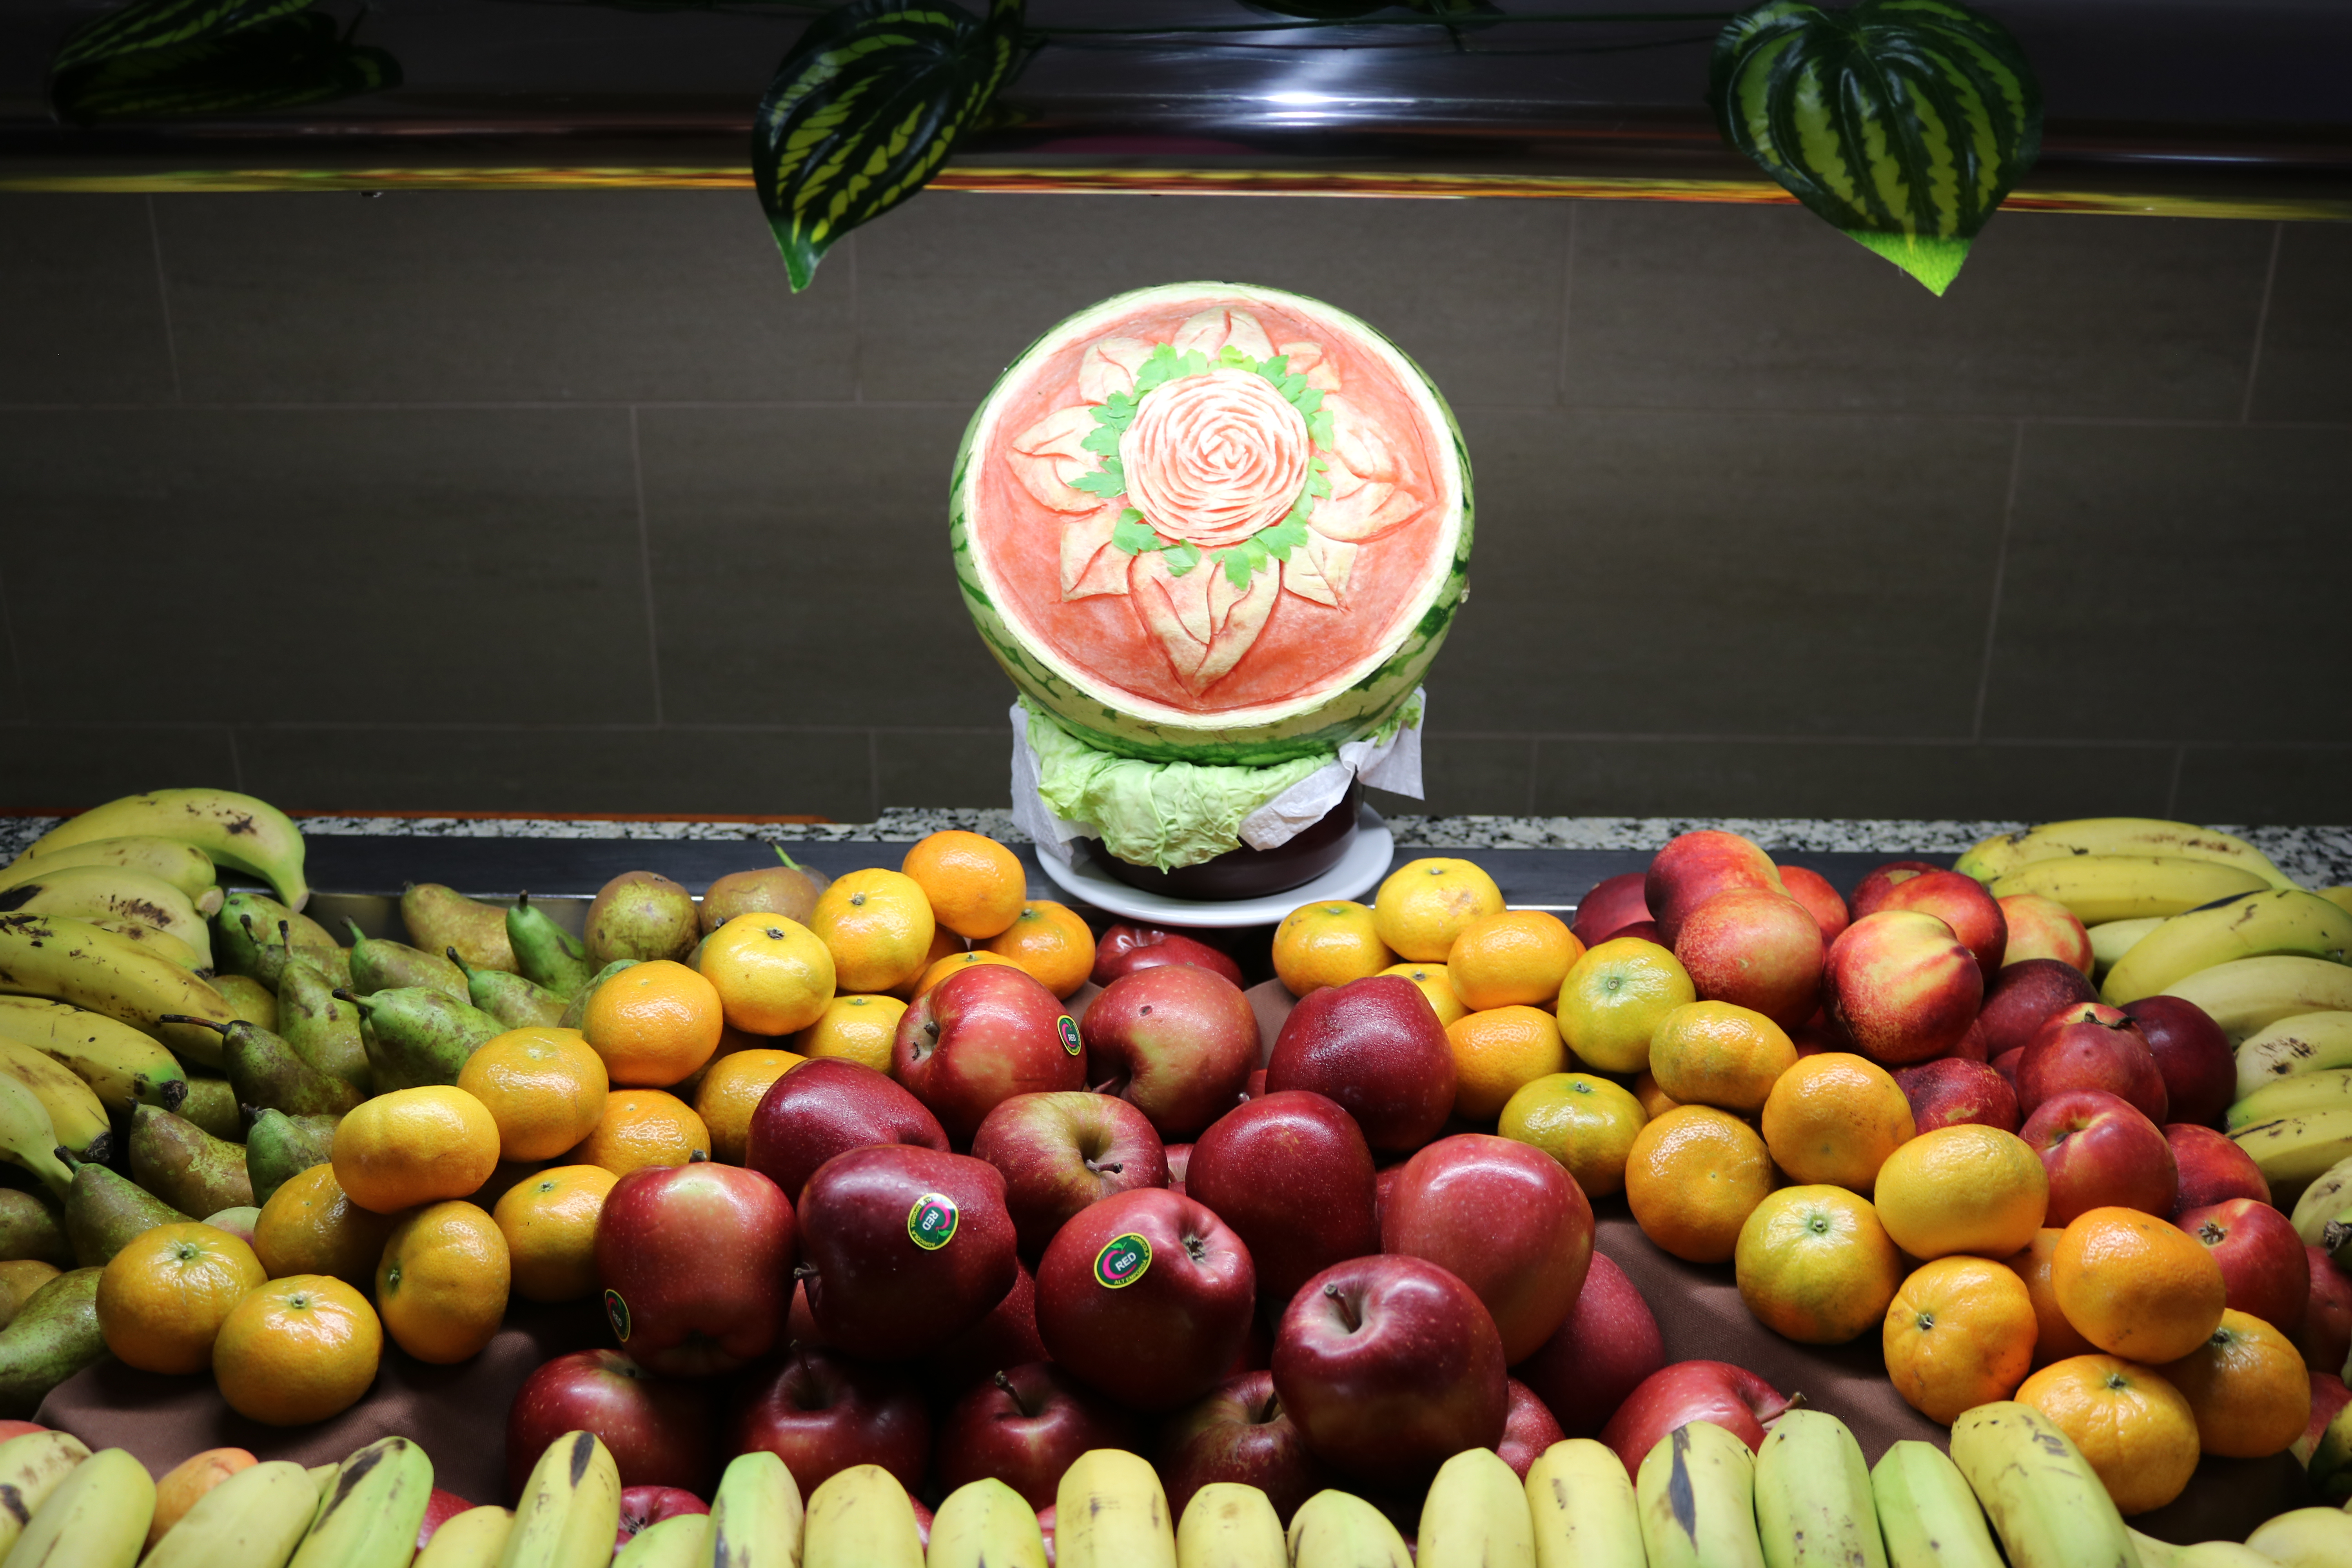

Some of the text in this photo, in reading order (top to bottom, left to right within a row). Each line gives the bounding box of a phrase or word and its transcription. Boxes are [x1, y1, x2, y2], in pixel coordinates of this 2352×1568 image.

[922, 1209, 939, 1231] RED
[1115, 1252, 1136, 1271] RED
[612, 1310, 622, 1327] RED
